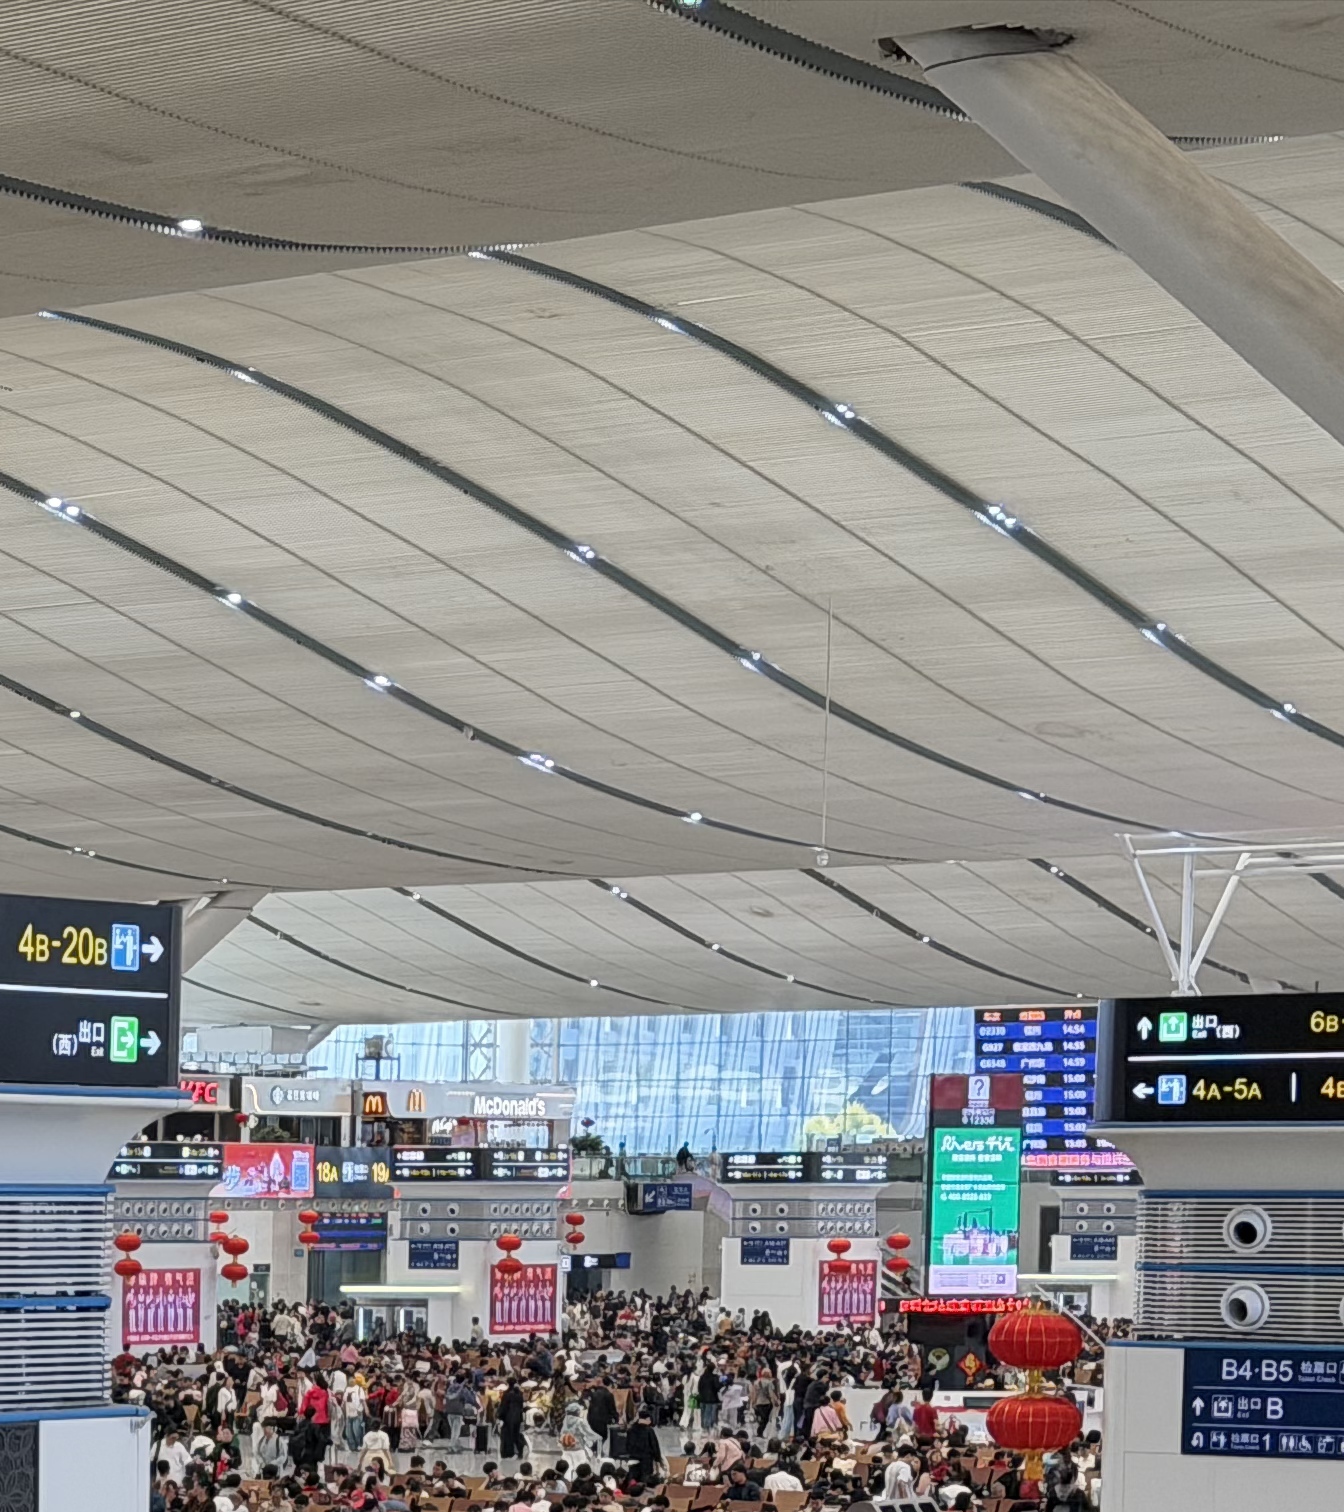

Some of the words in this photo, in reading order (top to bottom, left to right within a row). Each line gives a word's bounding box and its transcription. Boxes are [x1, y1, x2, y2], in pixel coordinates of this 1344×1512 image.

[18, 923, 108, 965] 4B-20B
[79, 1020, 105, 1044] 出口
[1192, 1014, 1217, 1029] 出口
[1310, 1010, 1344, 1032] 6B
[1192, 1077, 1262, 1100] 4A-5A
[474, 1095, 546, 1117] McDonald's
[316, 1161, 339, 1183] 18A
[372, 1162, 390, 1183] 19
[1300, 1360, 1338, 1374] 检票口
[1237, 1396, 1262, 1410] 出口
[1266, 1397, 1284, 1419] B
[1262, 1432, 1270, 1451] 1
